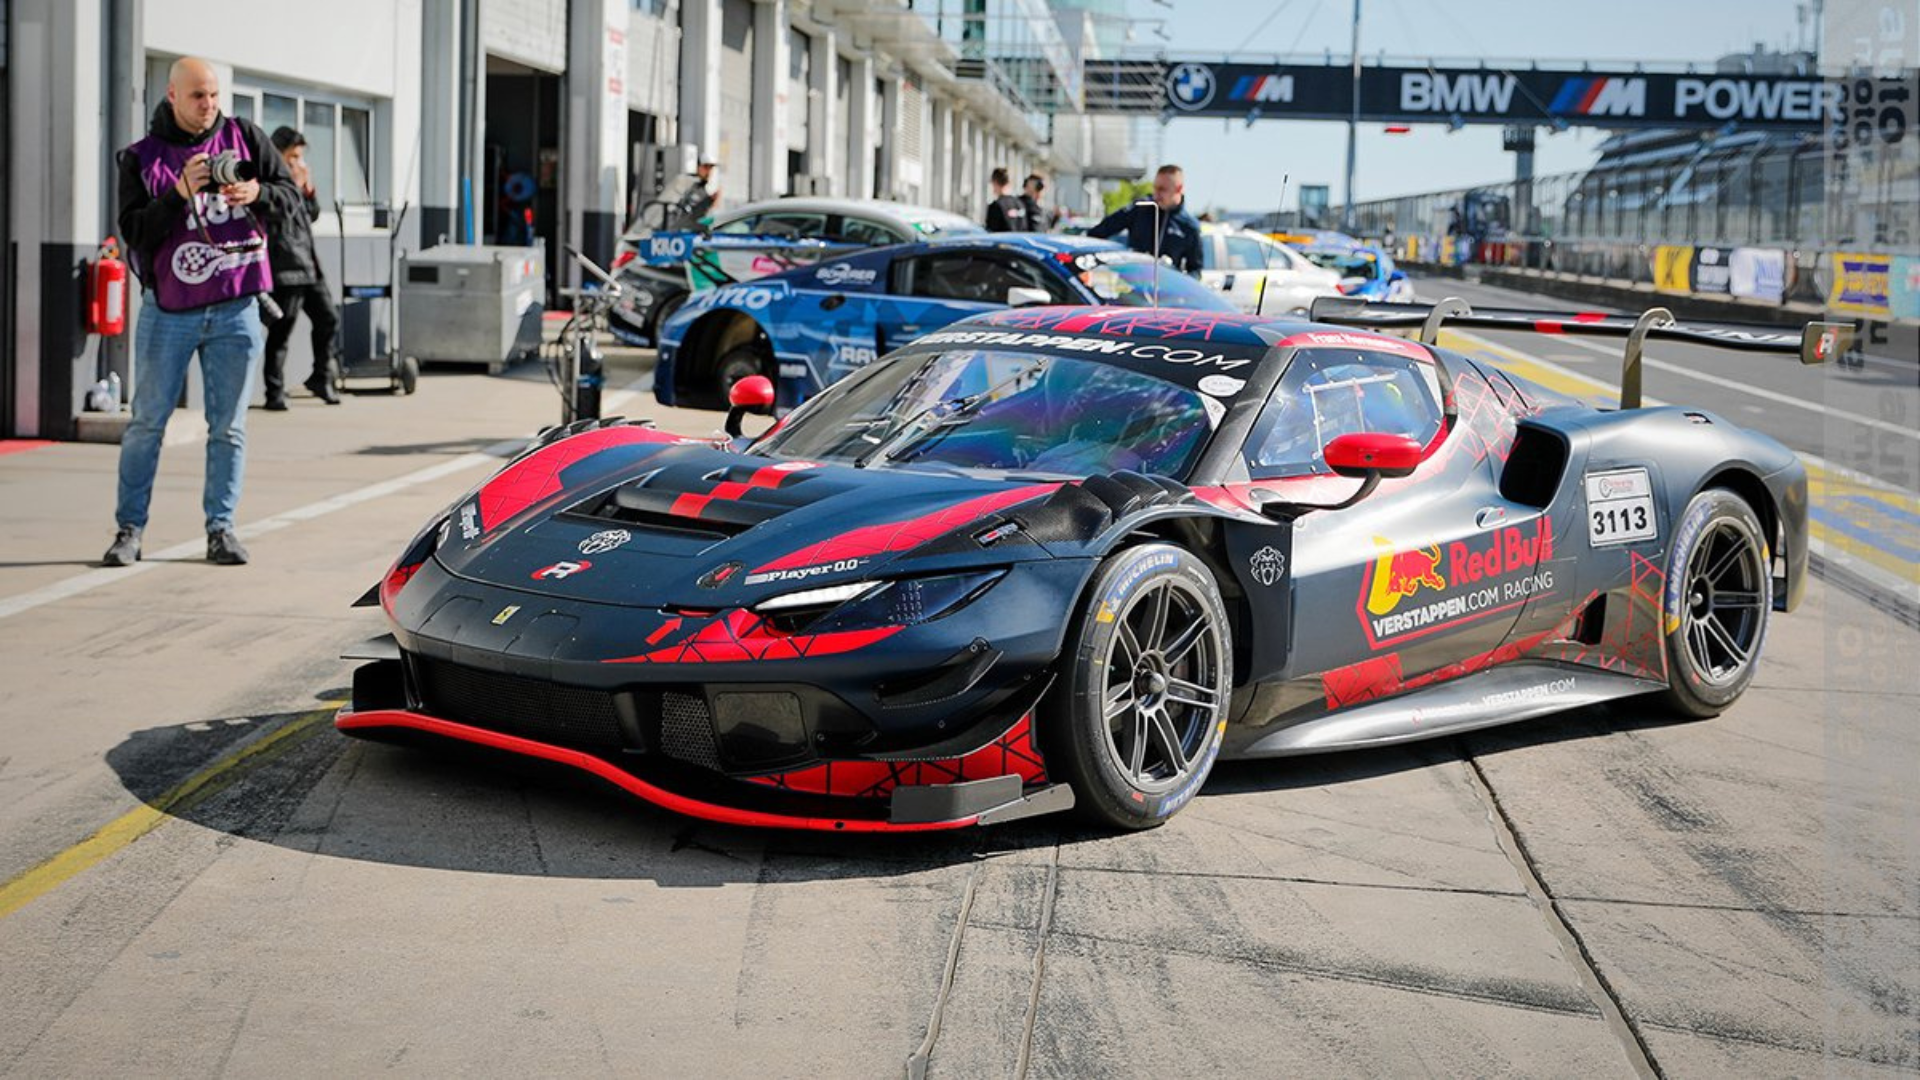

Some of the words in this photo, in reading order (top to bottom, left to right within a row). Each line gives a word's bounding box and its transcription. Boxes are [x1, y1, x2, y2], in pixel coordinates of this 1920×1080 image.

[1400, 73, 1516, 113] BMW
[1674, 79, 1841, 121] POWER
[1593, 506, 1648, 535] 3113
[1449, 528, 1502, 586] Red
[1505, 515, 1553, 572] Bull
[767, 564, 833, 582] Player
[1118, 553, 1174, 595] MICHELIN
[1372, 586, 1499, 638] VERSTAPPEN.COM
[1503, 571, 1554, 601] RACING
[1482, 677, 1576, 708] VERSTAPPEN.COM
